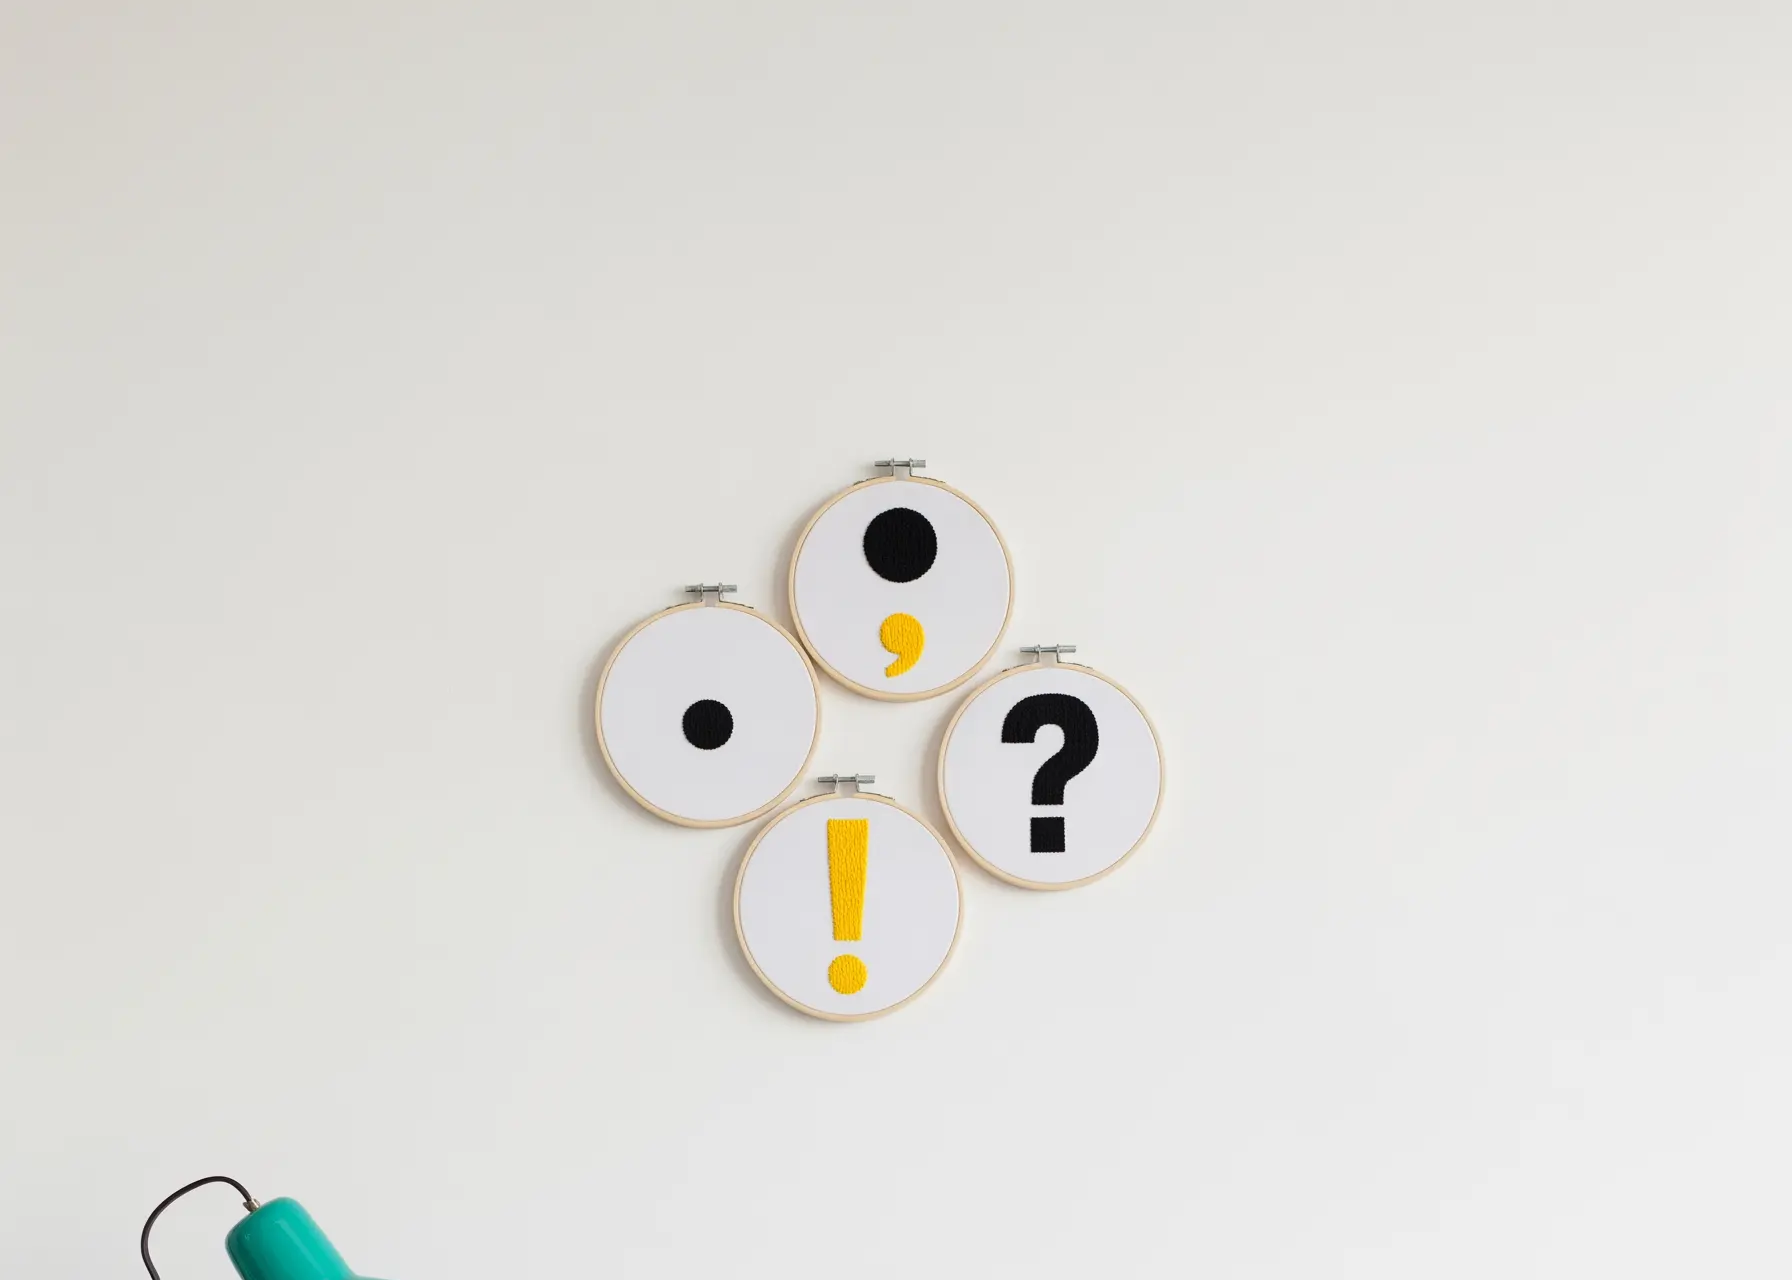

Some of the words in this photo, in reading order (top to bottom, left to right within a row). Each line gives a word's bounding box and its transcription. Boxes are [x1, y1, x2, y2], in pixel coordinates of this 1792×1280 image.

[863, 507, 938, 678] ;
[1001, 693, 1099, 853] ?
[827, 818, 869, 995] !
